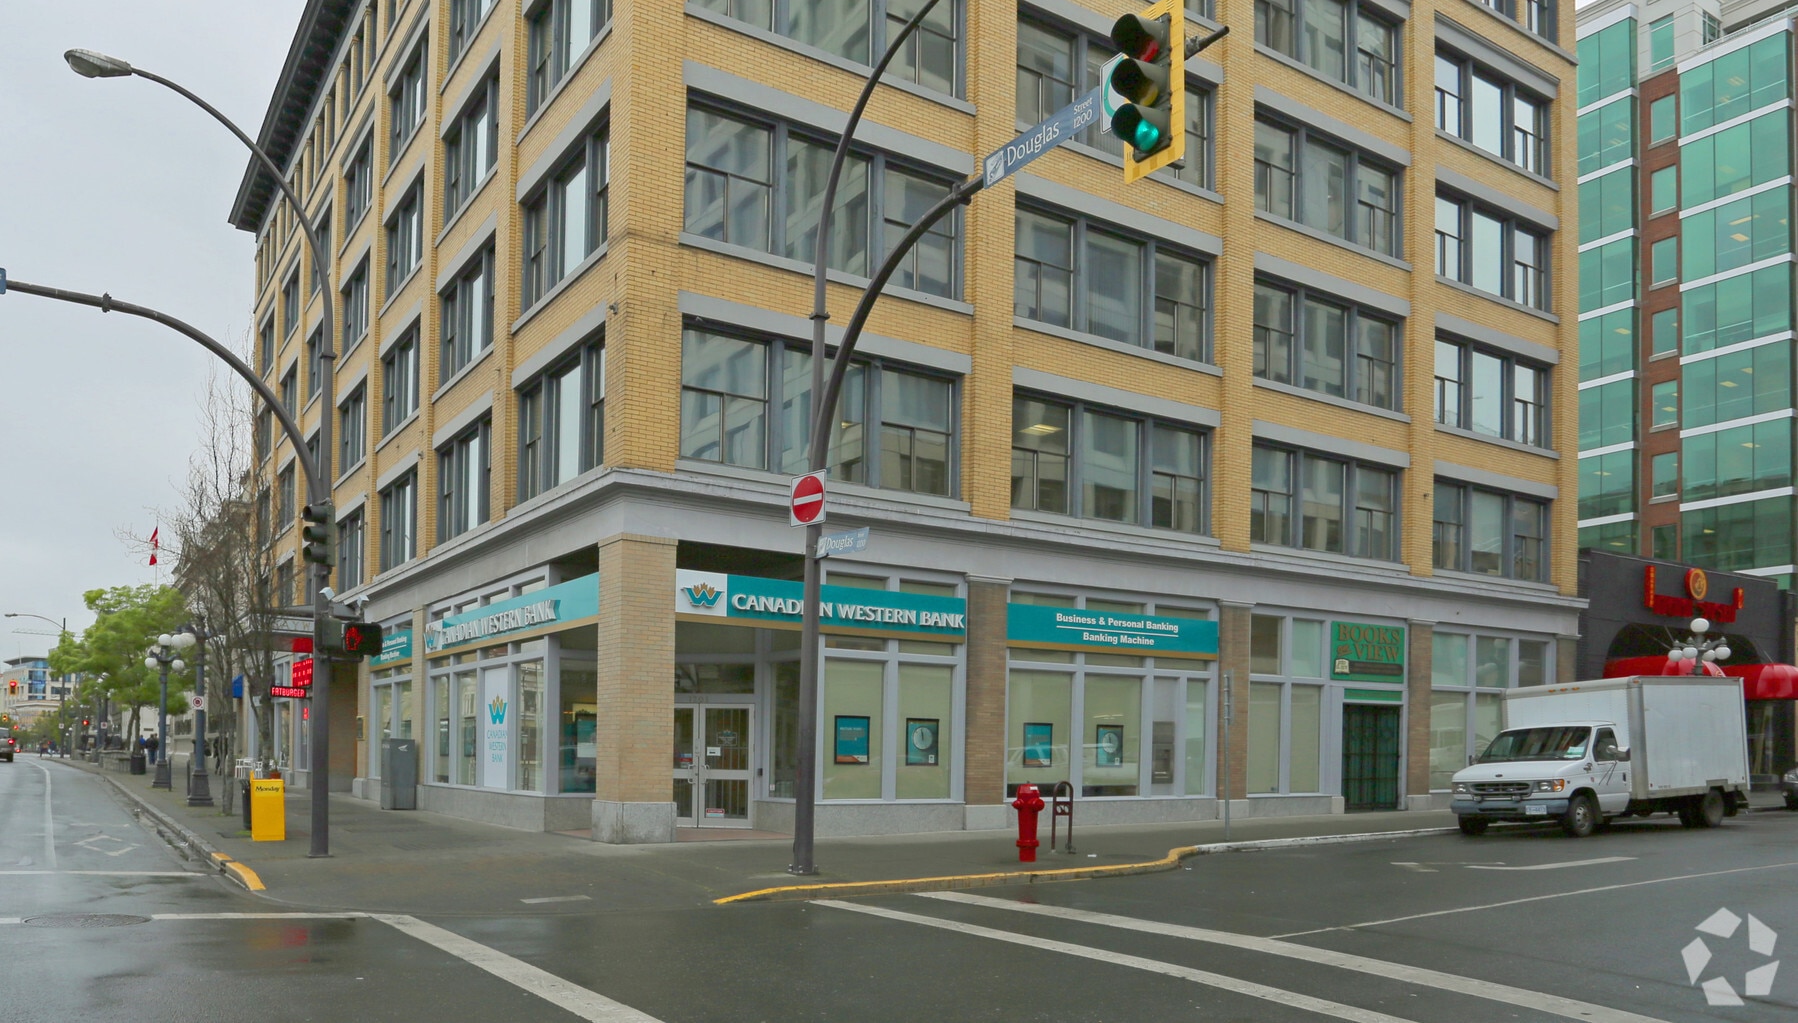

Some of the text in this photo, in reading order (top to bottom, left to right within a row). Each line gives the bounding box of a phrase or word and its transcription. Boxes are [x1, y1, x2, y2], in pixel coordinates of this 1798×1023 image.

[1073, 97, 1093, 115] Street
[1073, 109, 1093, 129] 1200
[1007, 122, 1060, 167] Douglas
[826, 536, 854, 551] Douglas
[480, 608, 522, 634] WESTERN
[522, 600, 557, 625] BANK
[731, 593, 965, 629] CANADIN WESTERN BANK
[1056, 613, 1179, 633] Business & Personal Banking
[1083, 632, 1155, 646] Banking Machine
[1338, 624, 1400, 644] BOOKS
[1354, 643, 1399, 662] VIEW
[271, 687, 305, 697] FATBURGER
